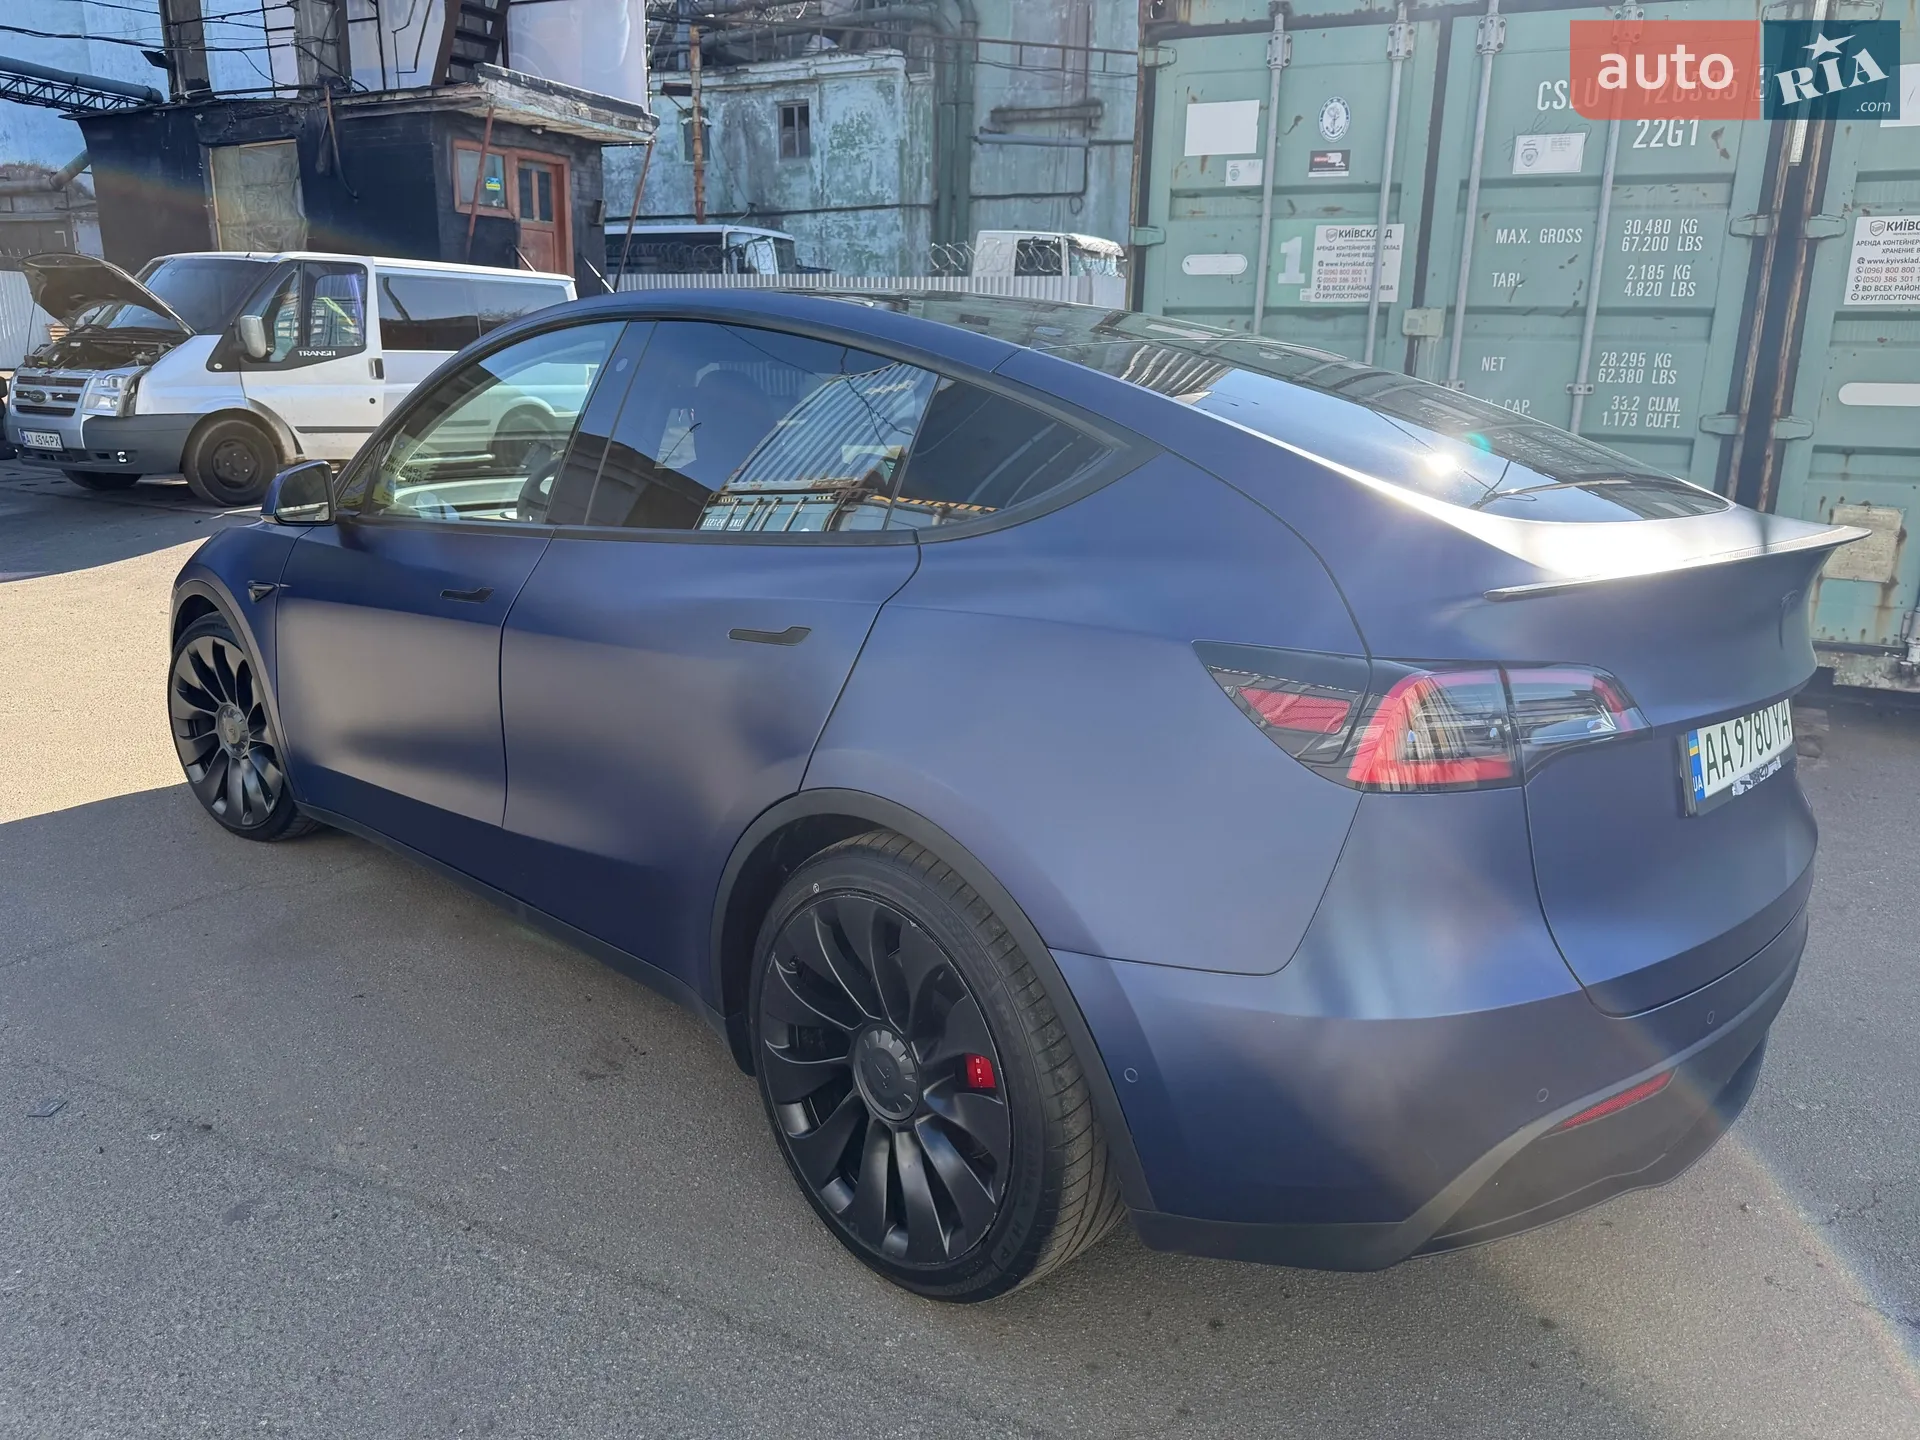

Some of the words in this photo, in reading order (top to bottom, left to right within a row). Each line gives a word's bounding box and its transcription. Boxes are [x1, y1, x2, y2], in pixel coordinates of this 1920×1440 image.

[1632, 116, 1700, 148] 22G1
[1338, 228, 1393, 239] КИЇВСКЛД
[1680, 218, 1698, 234] KG
[1496, 228, 1531, 244] MAX.
[1539, 228, 1583, 244] GROSS
[1677, 235, 1703, 251] LBS
[1278, 236, 1305, 283] 1
[1673, 264, 1691, 280] KG
[1670, 281, 1696, 297] LBS
[1481, 356, 1506, 372] NET
[1654, 352, 1672, 368] KG
[1652, 369, 1677, 385] LBS
[1611, 395, 1640, 411] 33.2
[1648, 396, 1681, 412] CU.M.
[1602, 411, 1638, 427] 1.173
[1645, 413, 1680, 429] CU.FT.
[1692, 774, 1704, 792] UA
